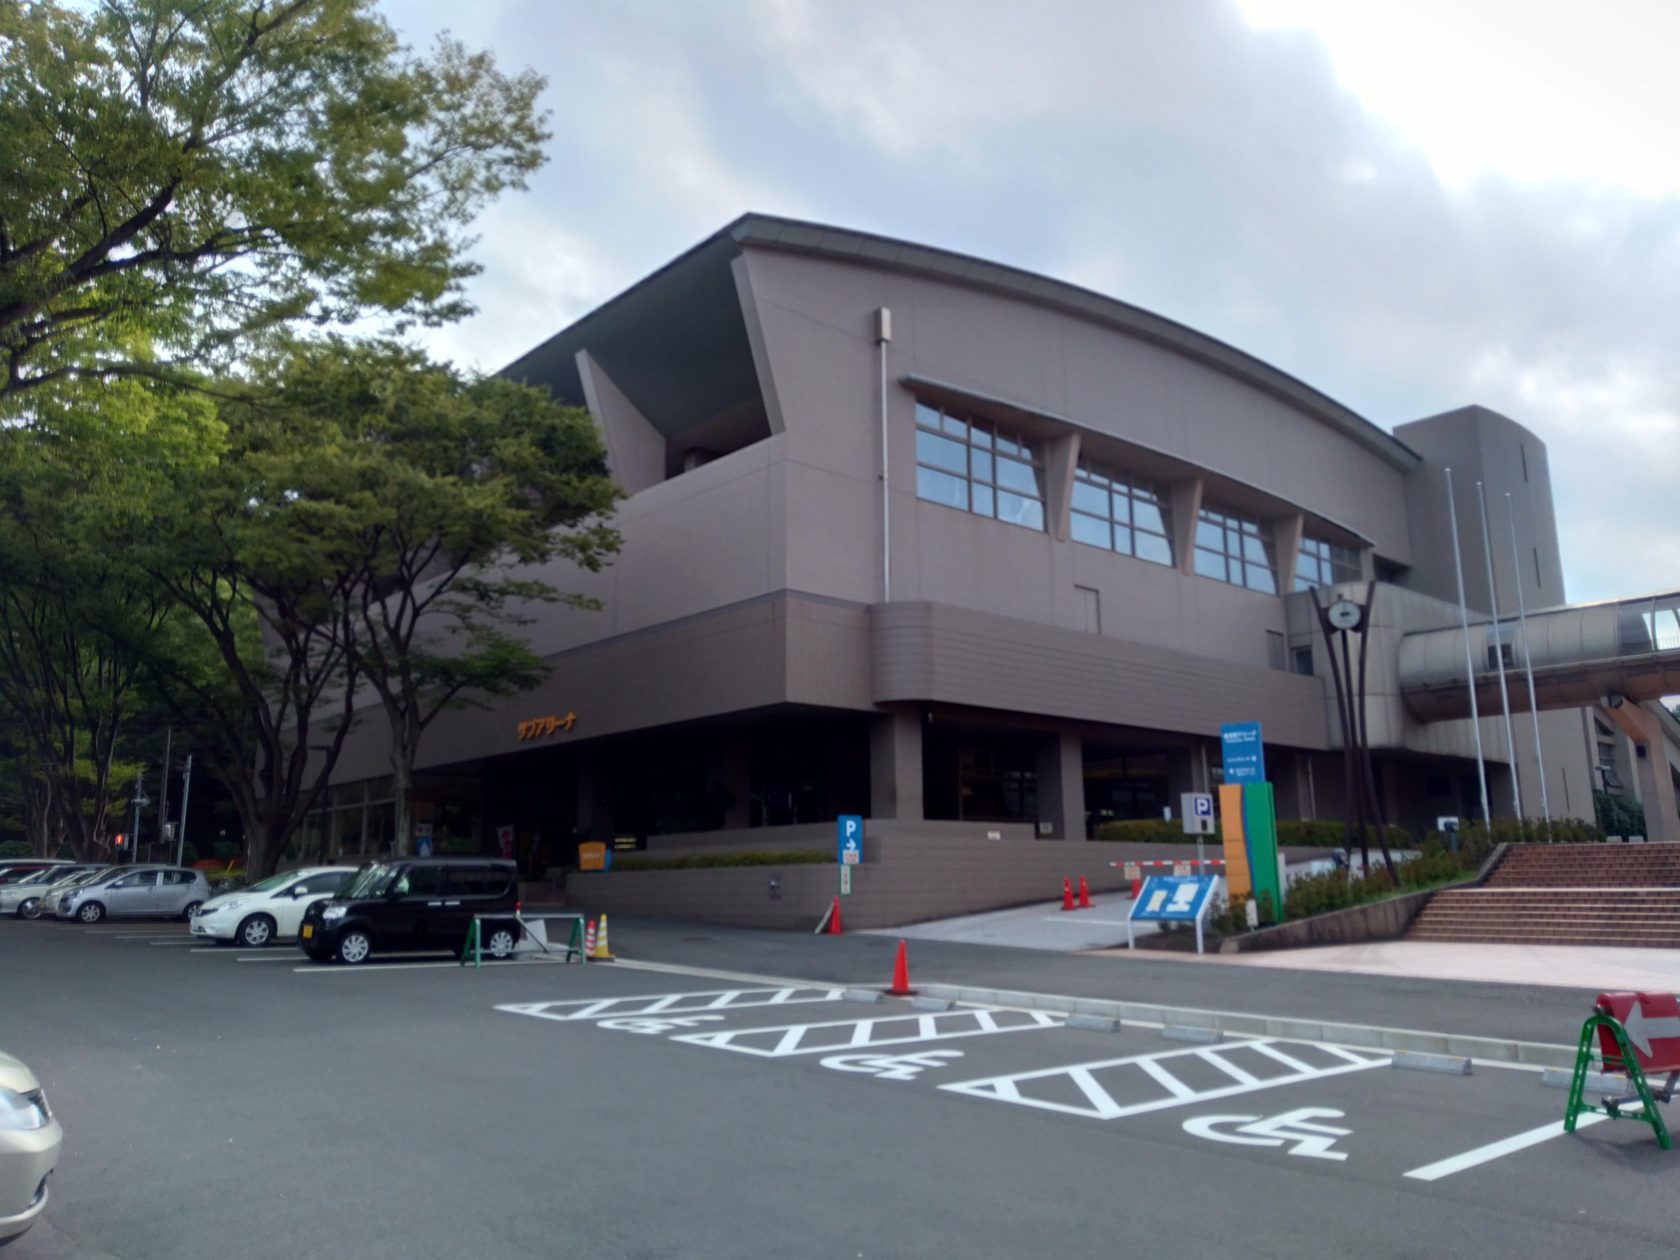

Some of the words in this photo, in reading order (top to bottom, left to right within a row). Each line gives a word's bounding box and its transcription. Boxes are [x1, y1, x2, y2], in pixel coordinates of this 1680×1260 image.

[518, 711, 577, 740] サブアリーナ
[1197, 799, 1208, 815] P
[846, 820, 856, 837] P
